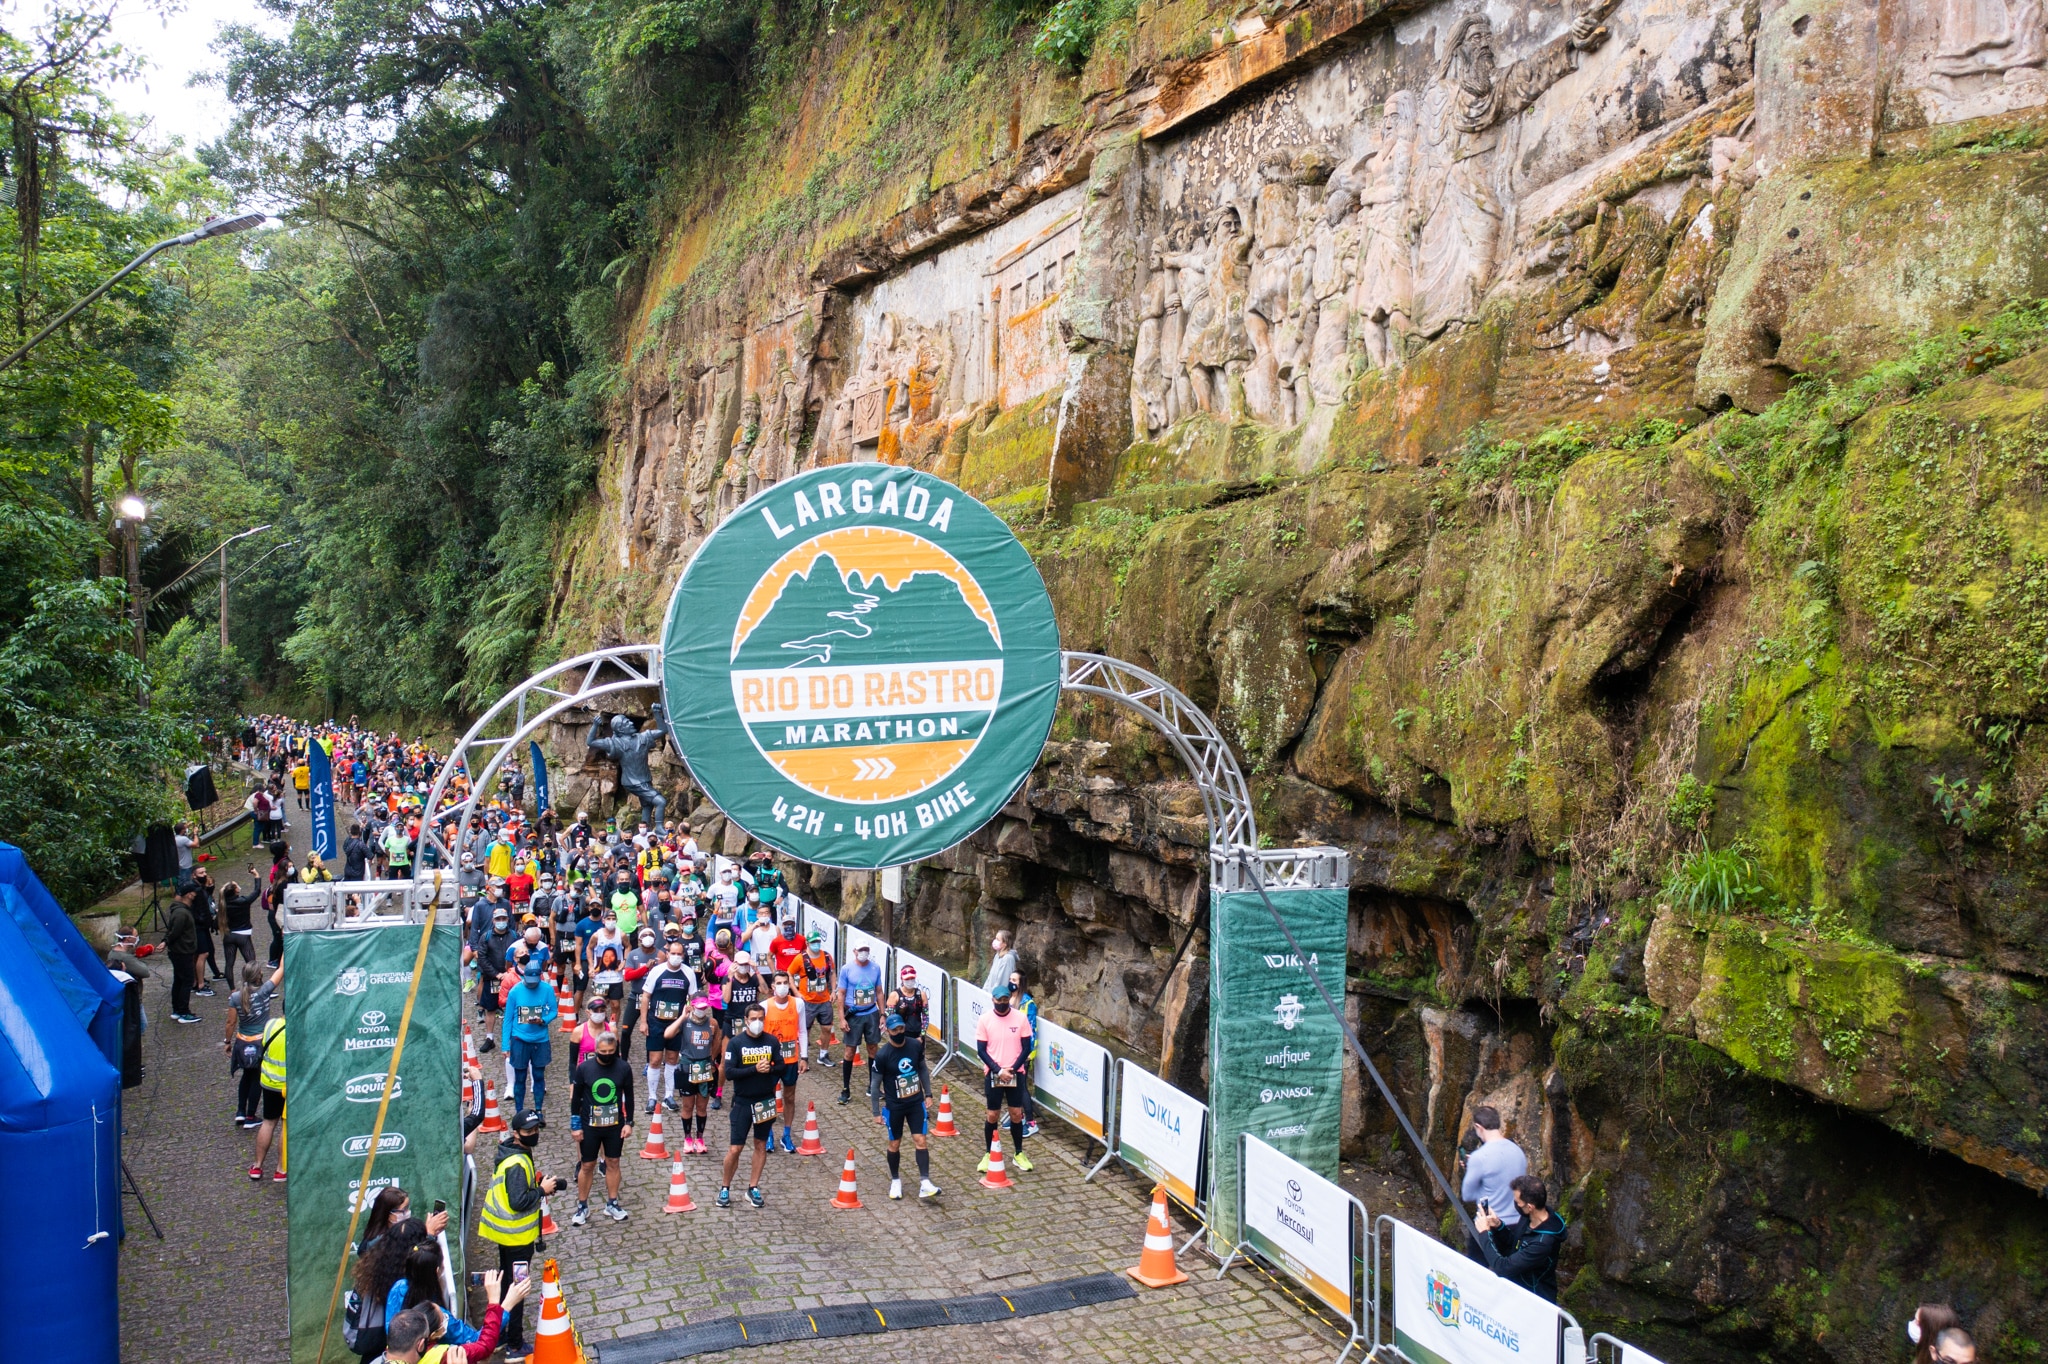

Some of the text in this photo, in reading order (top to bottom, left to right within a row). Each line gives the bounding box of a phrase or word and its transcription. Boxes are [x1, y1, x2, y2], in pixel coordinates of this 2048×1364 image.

[761, 479, 954, 540] LARGADA
[742, 667, 995, 713] RIO DO RASTRO
[786, 718, 957, 744] MARATHON
[772, 781, 976, 840] 42K 40K BIKE
[1263, 952, 1319, 968] DIKA
[357, 1025, 390, 1034] TOYOTA
[345, 1037, 398, 1049] Mercosu
[742, 1046, 772, 1055] CrossFit
[1265, 1046, 1310, 1068] unifique
[697, 1072, 711, 1081] 365
[1273, 1087, 1313, 1100] ANASOL
[762, 1108, 776, 1119] 375
[1142, 1094, 1181, 1136] DIKLA
[349, 1177, 390, 1188] Giando
[1284, 1197, 1305, 1216] TOYOTA
[1277, 1206, 1314, 1244] Mercosul
[1464, 1303, 1507, 1332] PREFEITURA
[1464, 1310, 1519, 1352] ORLEANS
